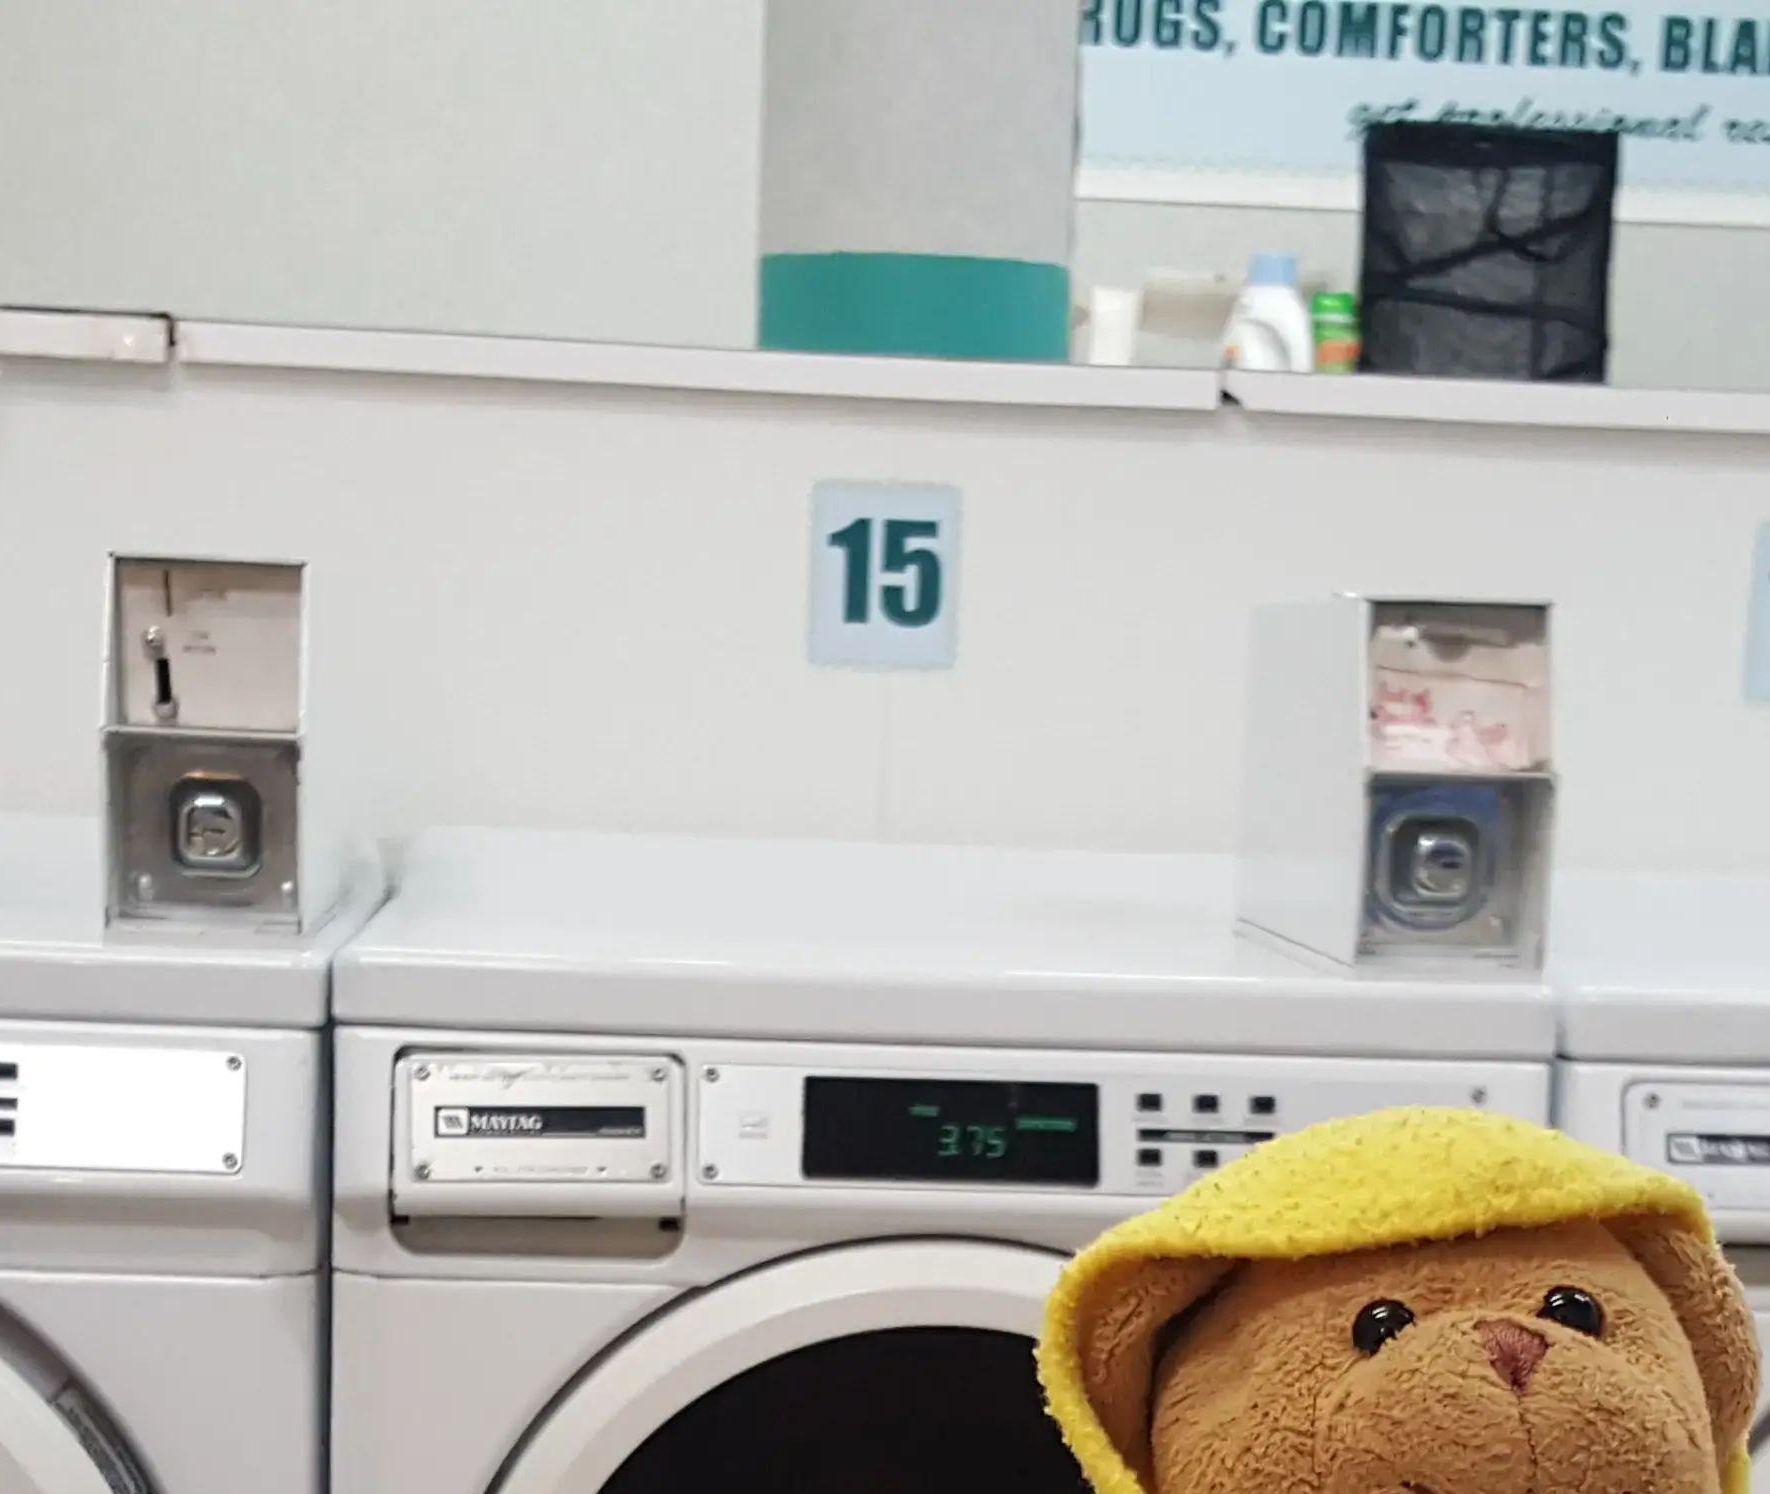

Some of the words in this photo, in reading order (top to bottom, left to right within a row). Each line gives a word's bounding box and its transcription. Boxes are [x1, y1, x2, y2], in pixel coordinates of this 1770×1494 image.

[1256, 0, 1644, 75] COMFORTERS,
[827, 516, 943, 629] 15
[469, 1112, 543, 1132] MAYTAG
